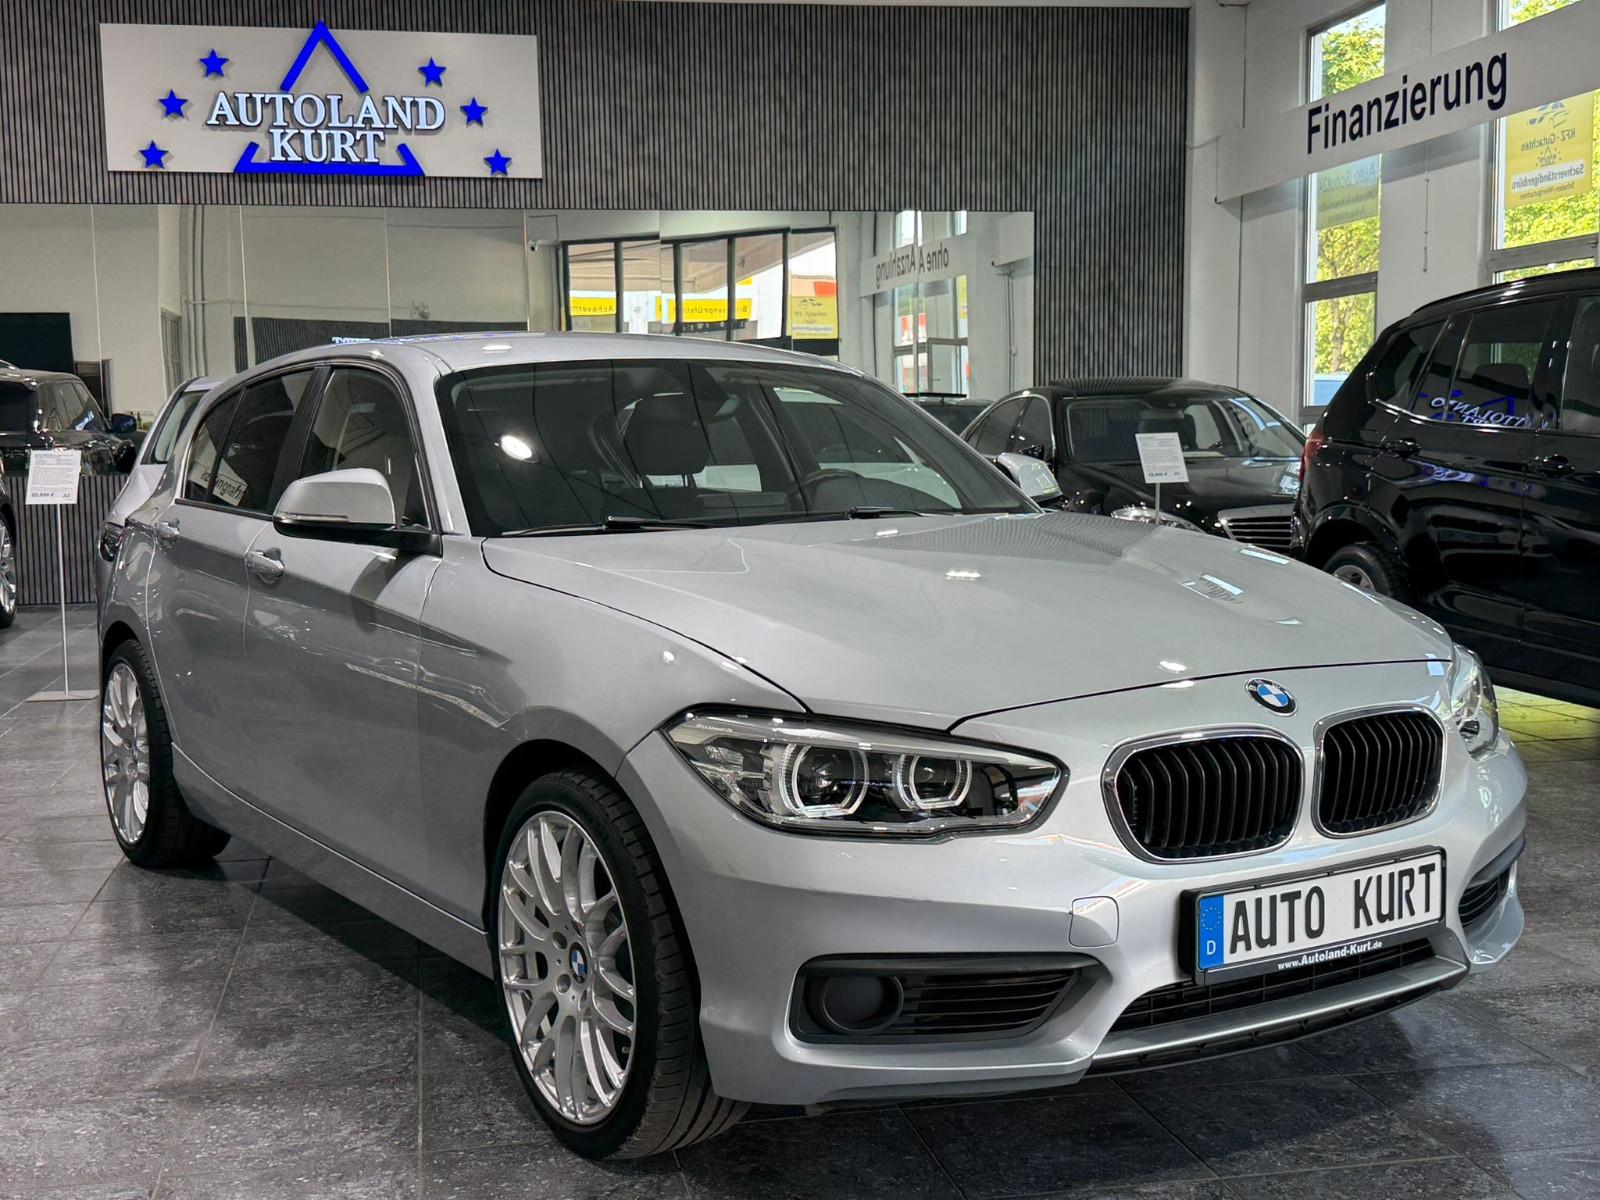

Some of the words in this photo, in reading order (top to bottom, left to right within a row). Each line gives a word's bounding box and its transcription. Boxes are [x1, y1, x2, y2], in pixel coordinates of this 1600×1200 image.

[204, 91, 446, 131] AUTOLAND
[1307, 52, 1507, 154] Finanzierung
[269, 128, 385, 163] KURT
[1230, 885, 1326, 954] AUTO
[1353, 863, 1436, 929] KURT
[1206, 940, 1217, 956] D
[1277, 941, 1383, 970] www.Autoland-Kurt.de
